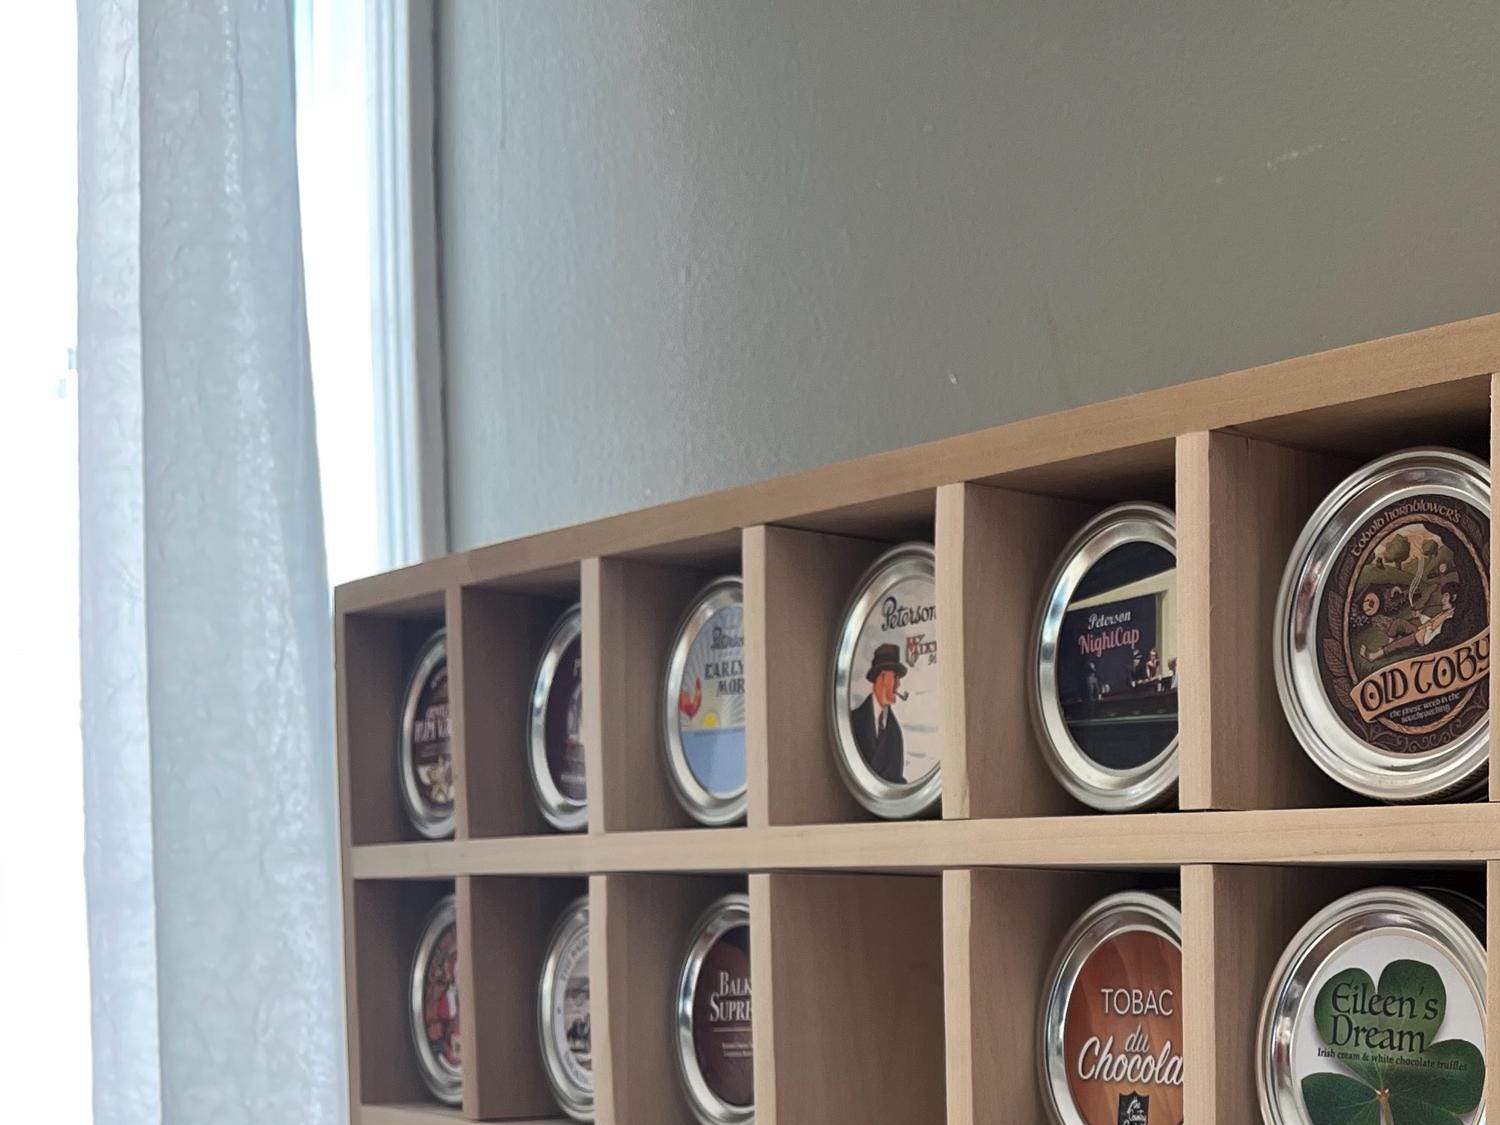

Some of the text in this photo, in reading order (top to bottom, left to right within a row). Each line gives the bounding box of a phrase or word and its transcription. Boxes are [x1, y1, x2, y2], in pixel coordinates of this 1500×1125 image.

[1087, 610, 1131, 630] Peterson
[1100, 987, 1174, 1016] TOBAC
[1331, 981, 1439, 1021] Eileen's
[1125, 1024, 1150, 1052] du
[1330, 1013, 1425, 1053] Dream
[1317, 1047, 1336, 1058] Irish
[1337, 1051, 1360, 1061] cream
[1361, 1052, 1370, 1062] &
[1371, 1053, 1394, 1065] white
[1395, 1055, 1435, 1068] chocolate
